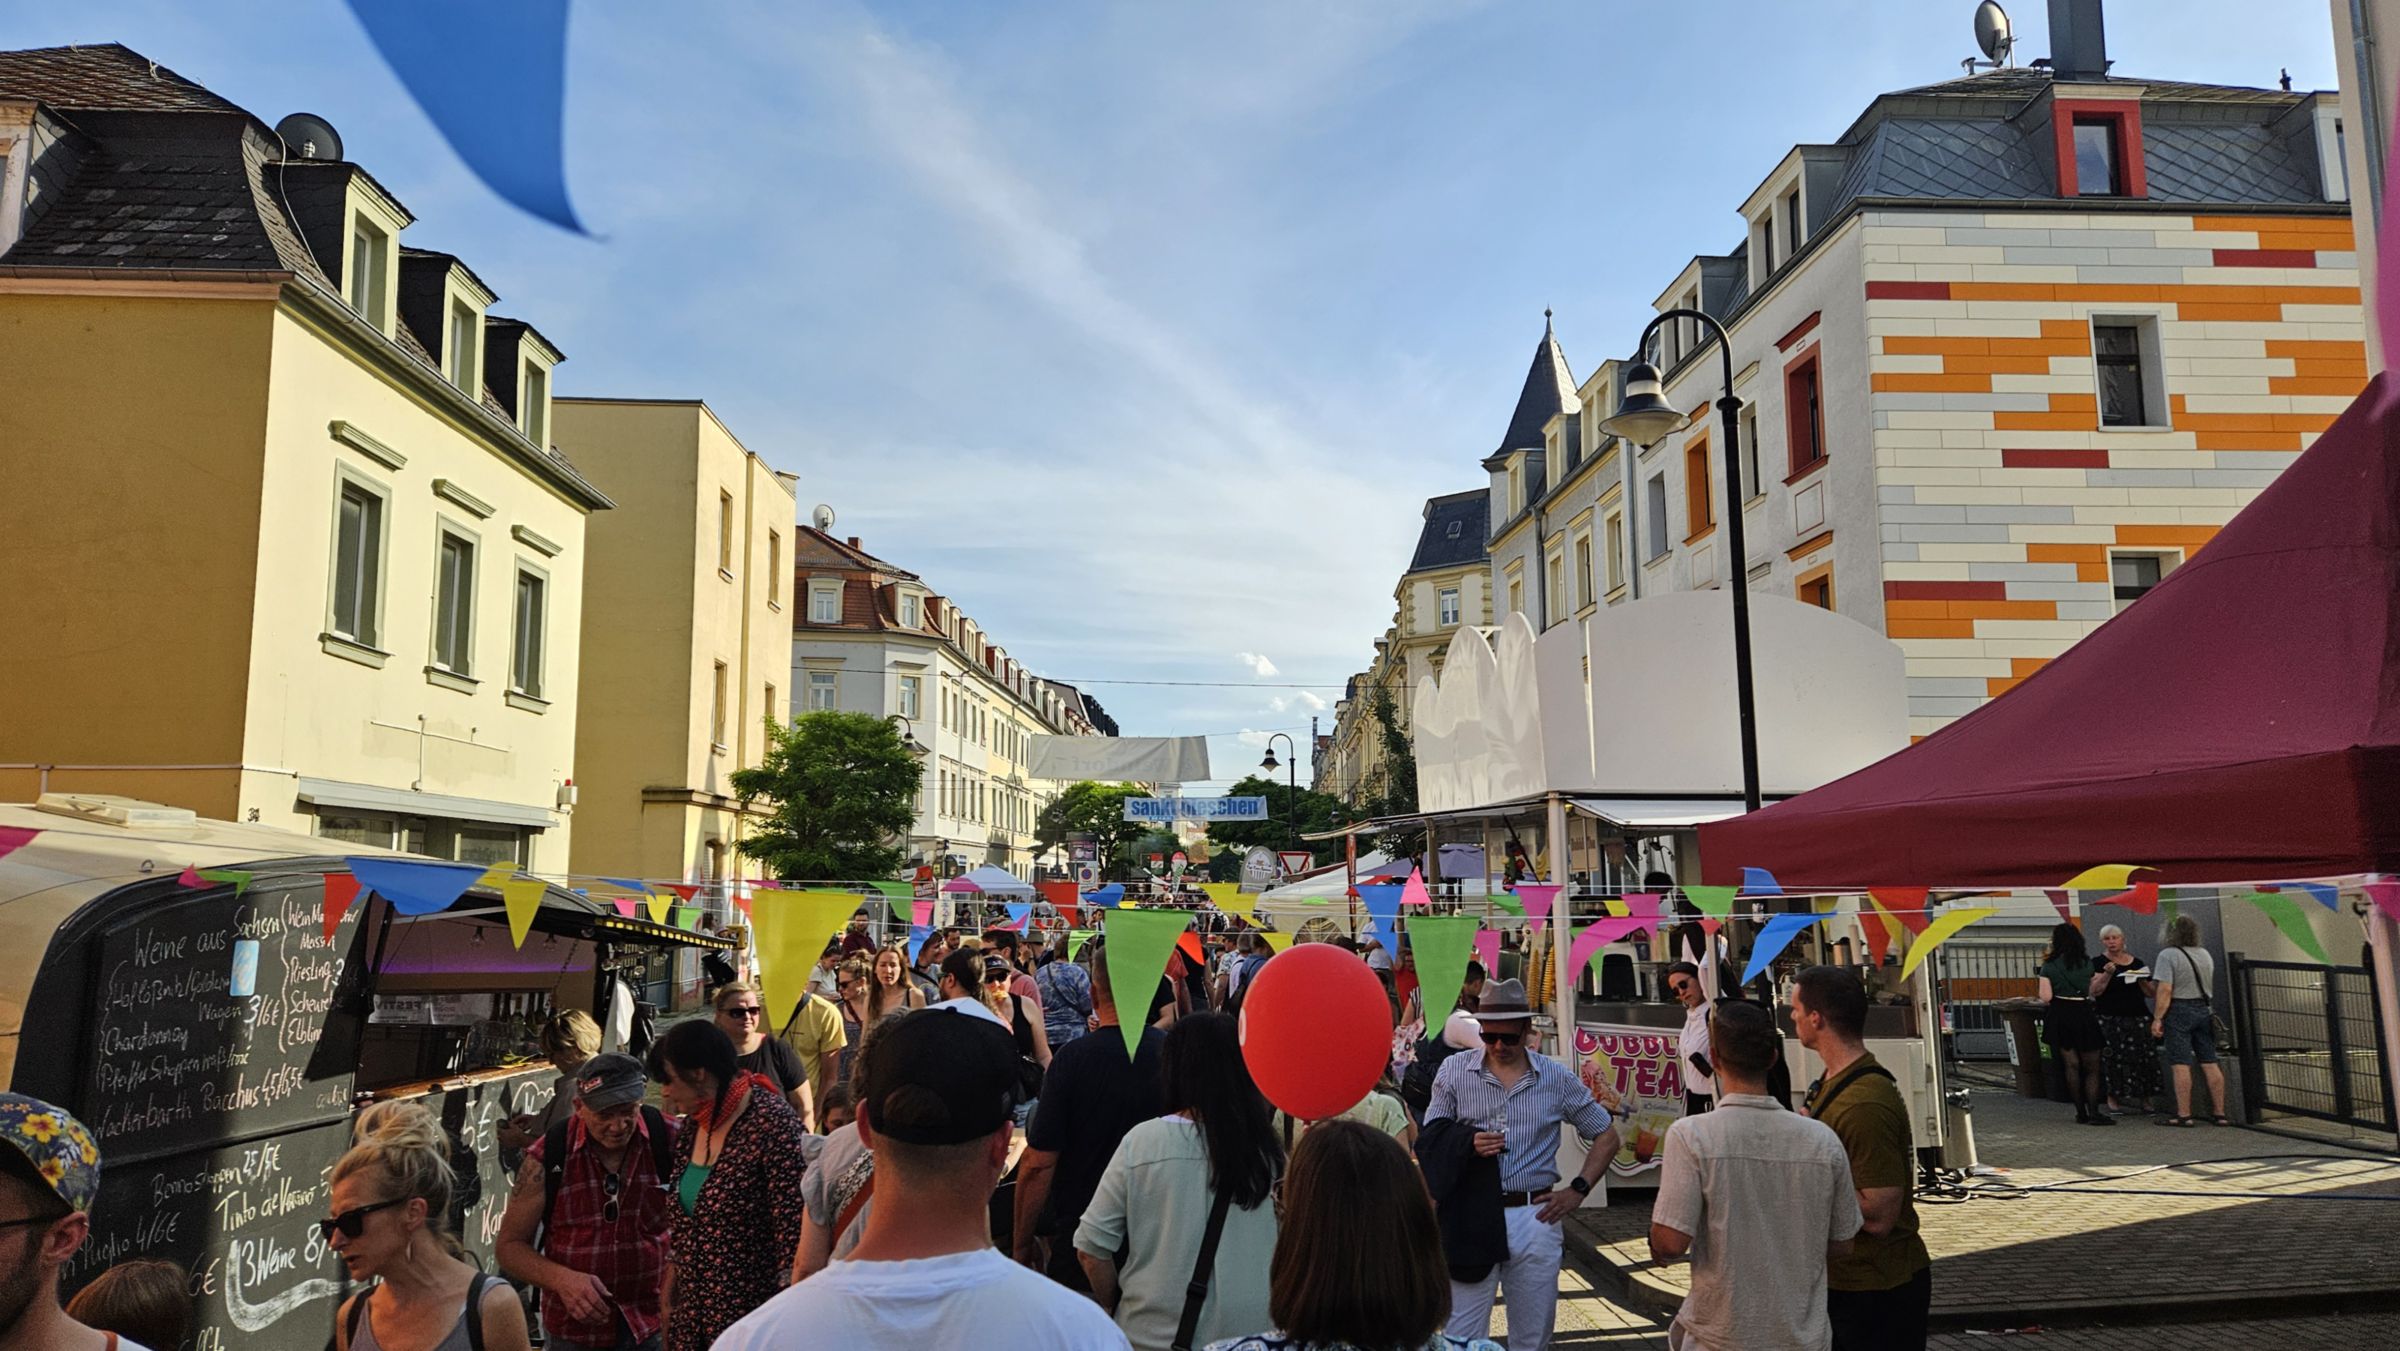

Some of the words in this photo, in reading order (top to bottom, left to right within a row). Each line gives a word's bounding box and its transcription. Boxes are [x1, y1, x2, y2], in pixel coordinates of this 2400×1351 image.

[1131, 797, 1176, 816] sankt
[135, 927, 188, 968] Weine
[197, 929, 226, 953] aus
[231, 905, 280, 940] Sachsen
[300, 933, 336, 951] Meissn
[199, 1002, 242, 1031] Wagen
[104, 1021, 189, 1056] Chardonnay
[1574, 1025, 1681, 1058] BUBBL
[200, 1072, 260, 1112] Bacchus
[1610, 1056, 1682, 1099] TEA
[136, 1209, 182, 1252] 4/6€
[215, 1190, 256, 1232] Tinto
[241, 1240, 256, 1288] 3
[256, 1237, 297, 1287] Weine
